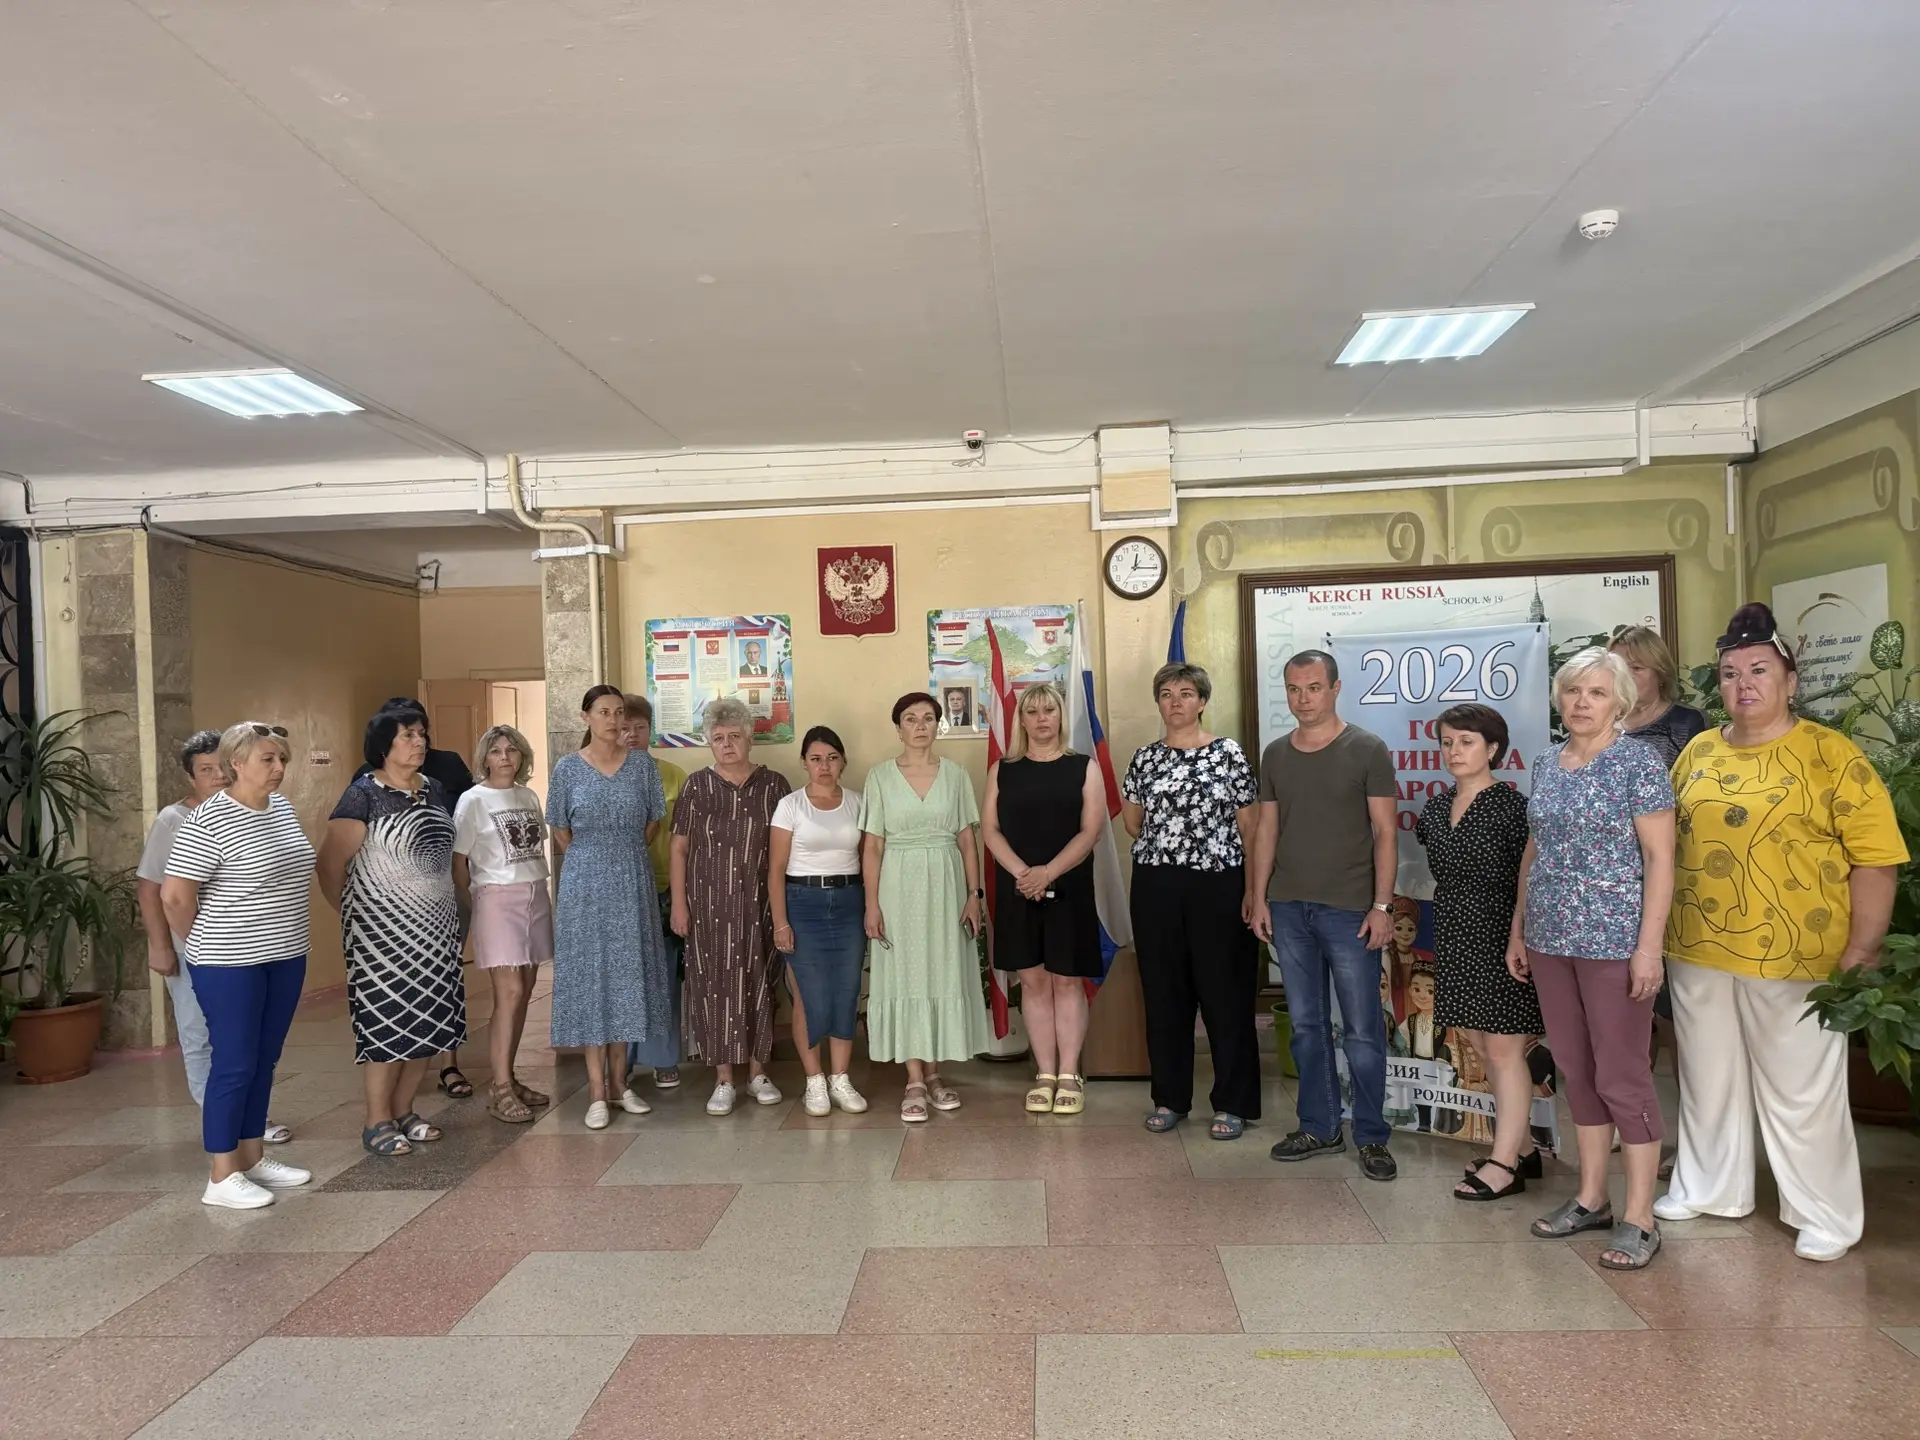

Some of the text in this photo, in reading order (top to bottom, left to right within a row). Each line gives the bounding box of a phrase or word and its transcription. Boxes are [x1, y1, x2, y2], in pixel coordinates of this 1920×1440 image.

[1603, 575, 1650, 589] English
[1309, 586, 1445, 603] KERCH RUSSIA
[1442, 595, 1503, 605] SCHOOL № 19
[1359, 641, 1519, 705] 2026
[1408, 719, 1439, 741] ГО
[1386, 1064, 1420, 1080] СИЯ
[1413, 1087, 1484, 1111] РОДИНА
